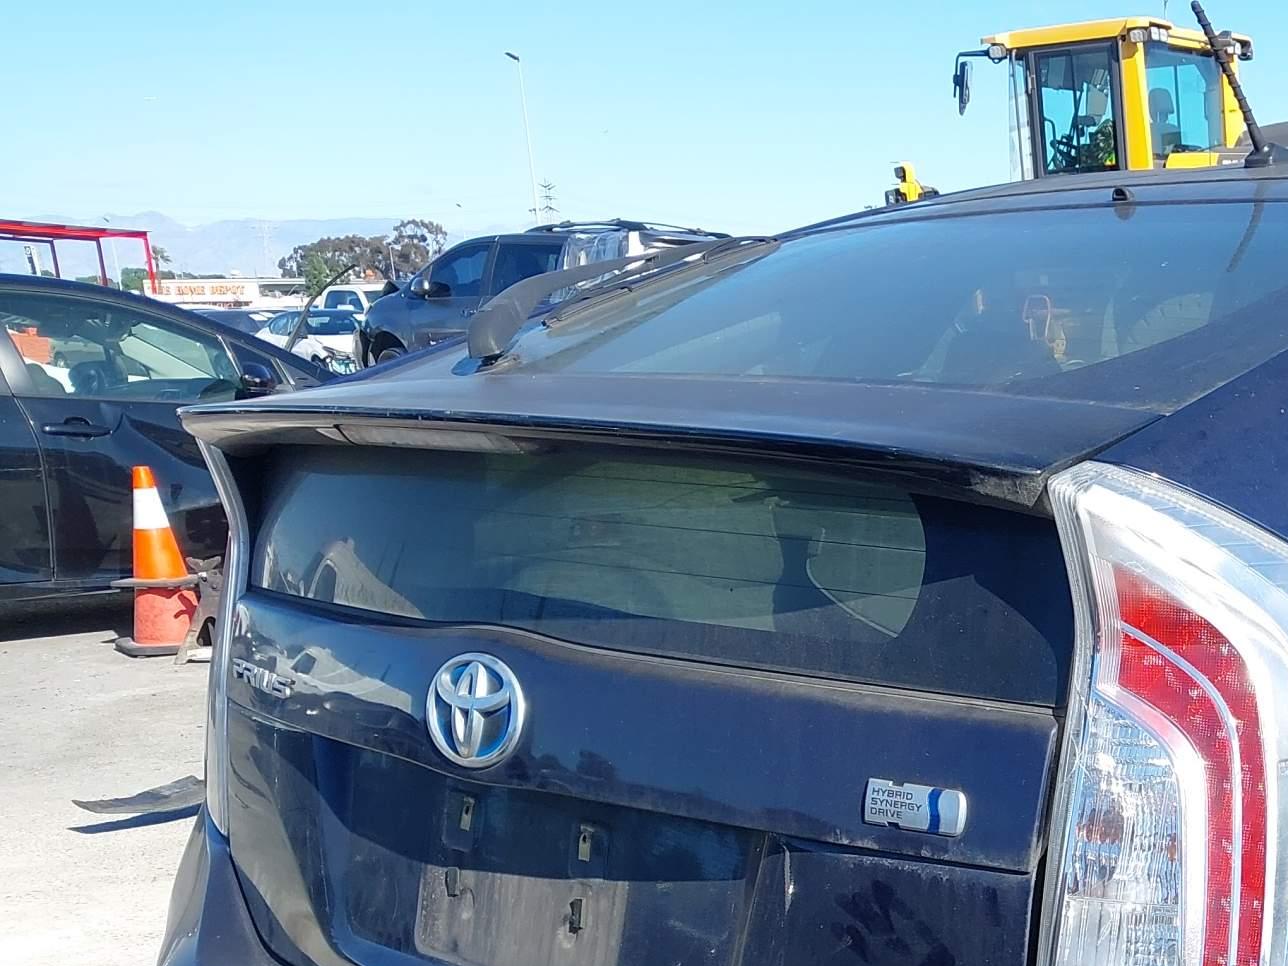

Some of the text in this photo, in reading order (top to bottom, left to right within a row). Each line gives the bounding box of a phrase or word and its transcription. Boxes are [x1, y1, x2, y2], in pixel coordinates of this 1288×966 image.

[175, 285, 206, 295] HOME
[210, 285, 245, 295] DEPOT
[232, 658, 291, 699] PRIUS
[871, 787, 913, 801] HYBRID
[870, 796, 922, 812] SYNERGY
[870, 806, 903, 819] DRIVE
